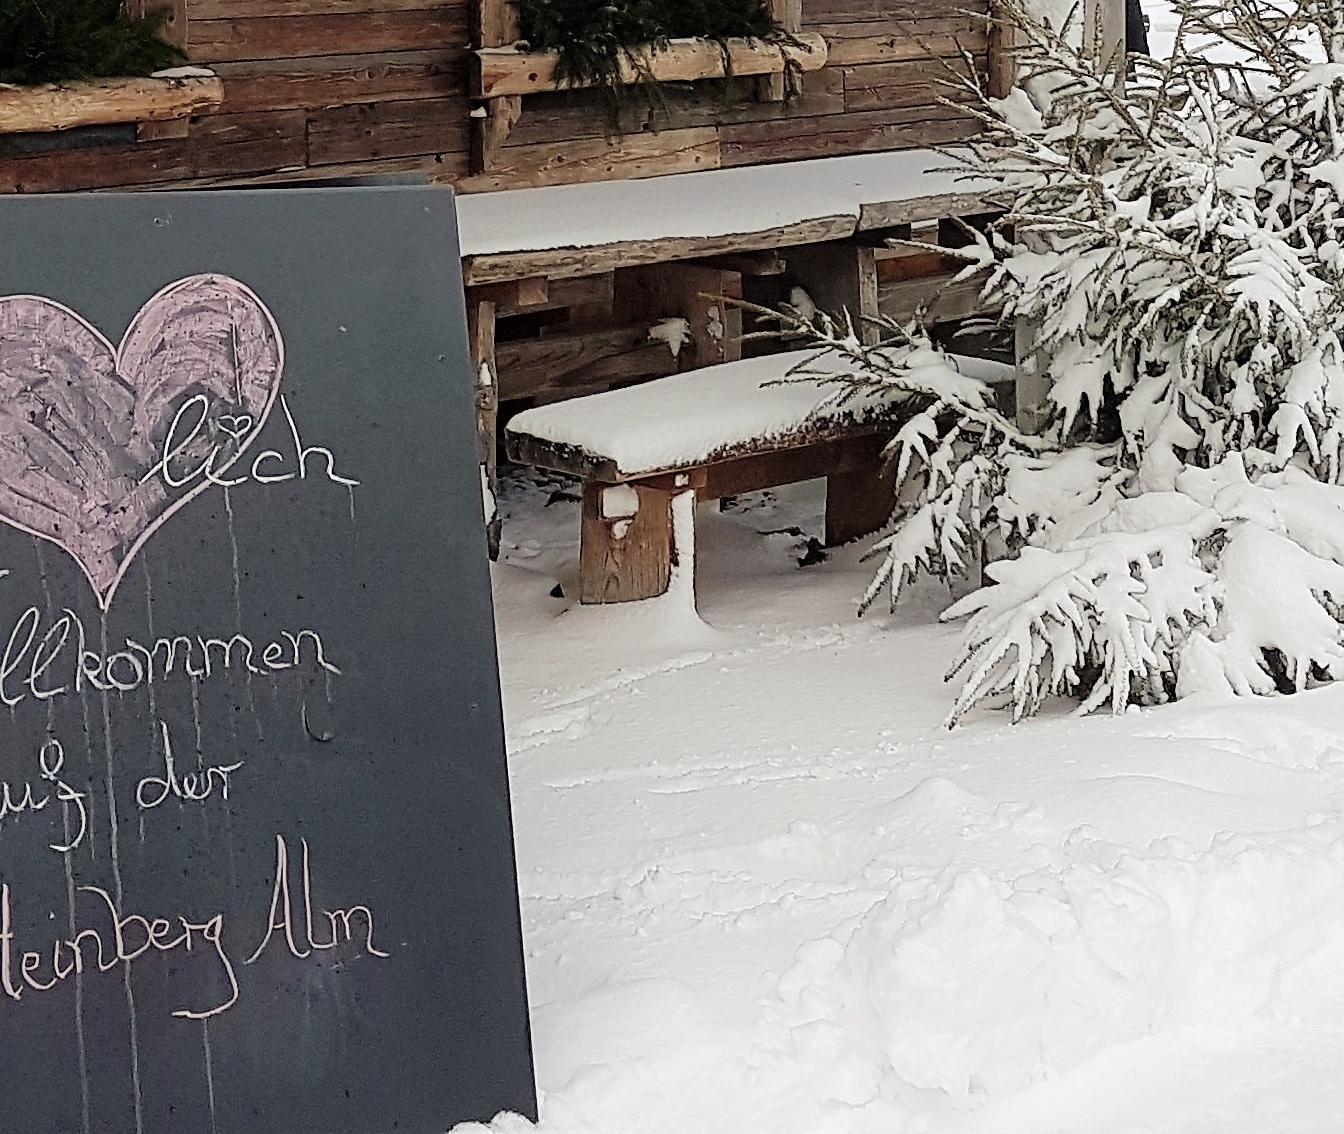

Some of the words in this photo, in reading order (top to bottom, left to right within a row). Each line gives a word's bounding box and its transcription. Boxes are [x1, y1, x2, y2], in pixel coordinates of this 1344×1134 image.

[138, 393, 360, 488] lich
[135, 720, 245, 809] der
[242, 833, 390, 965] Alm
